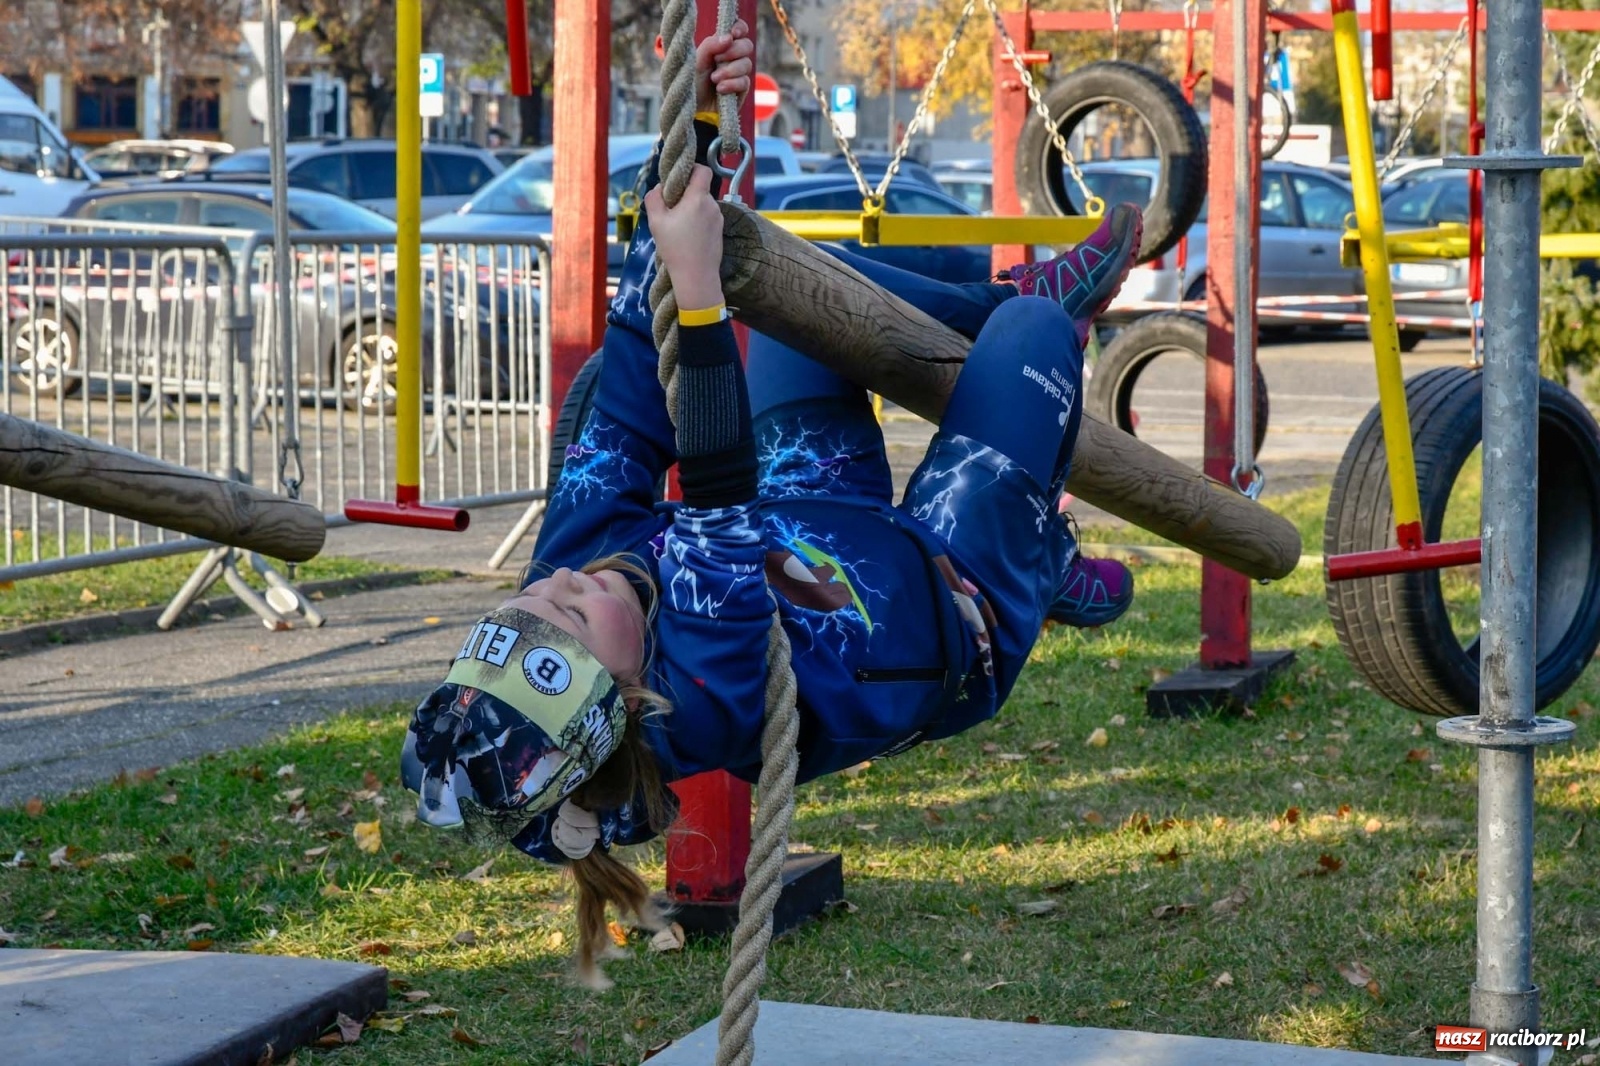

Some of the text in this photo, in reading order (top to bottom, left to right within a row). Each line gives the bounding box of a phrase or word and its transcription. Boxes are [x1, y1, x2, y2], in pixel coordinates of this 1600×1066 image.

[1022, 365, 1062, 400] ciekawa
[1050, 367, 1074, 394] plama
[524, 668, 558, 695] BARBARIANS
[536, 657, 562, 685] B
